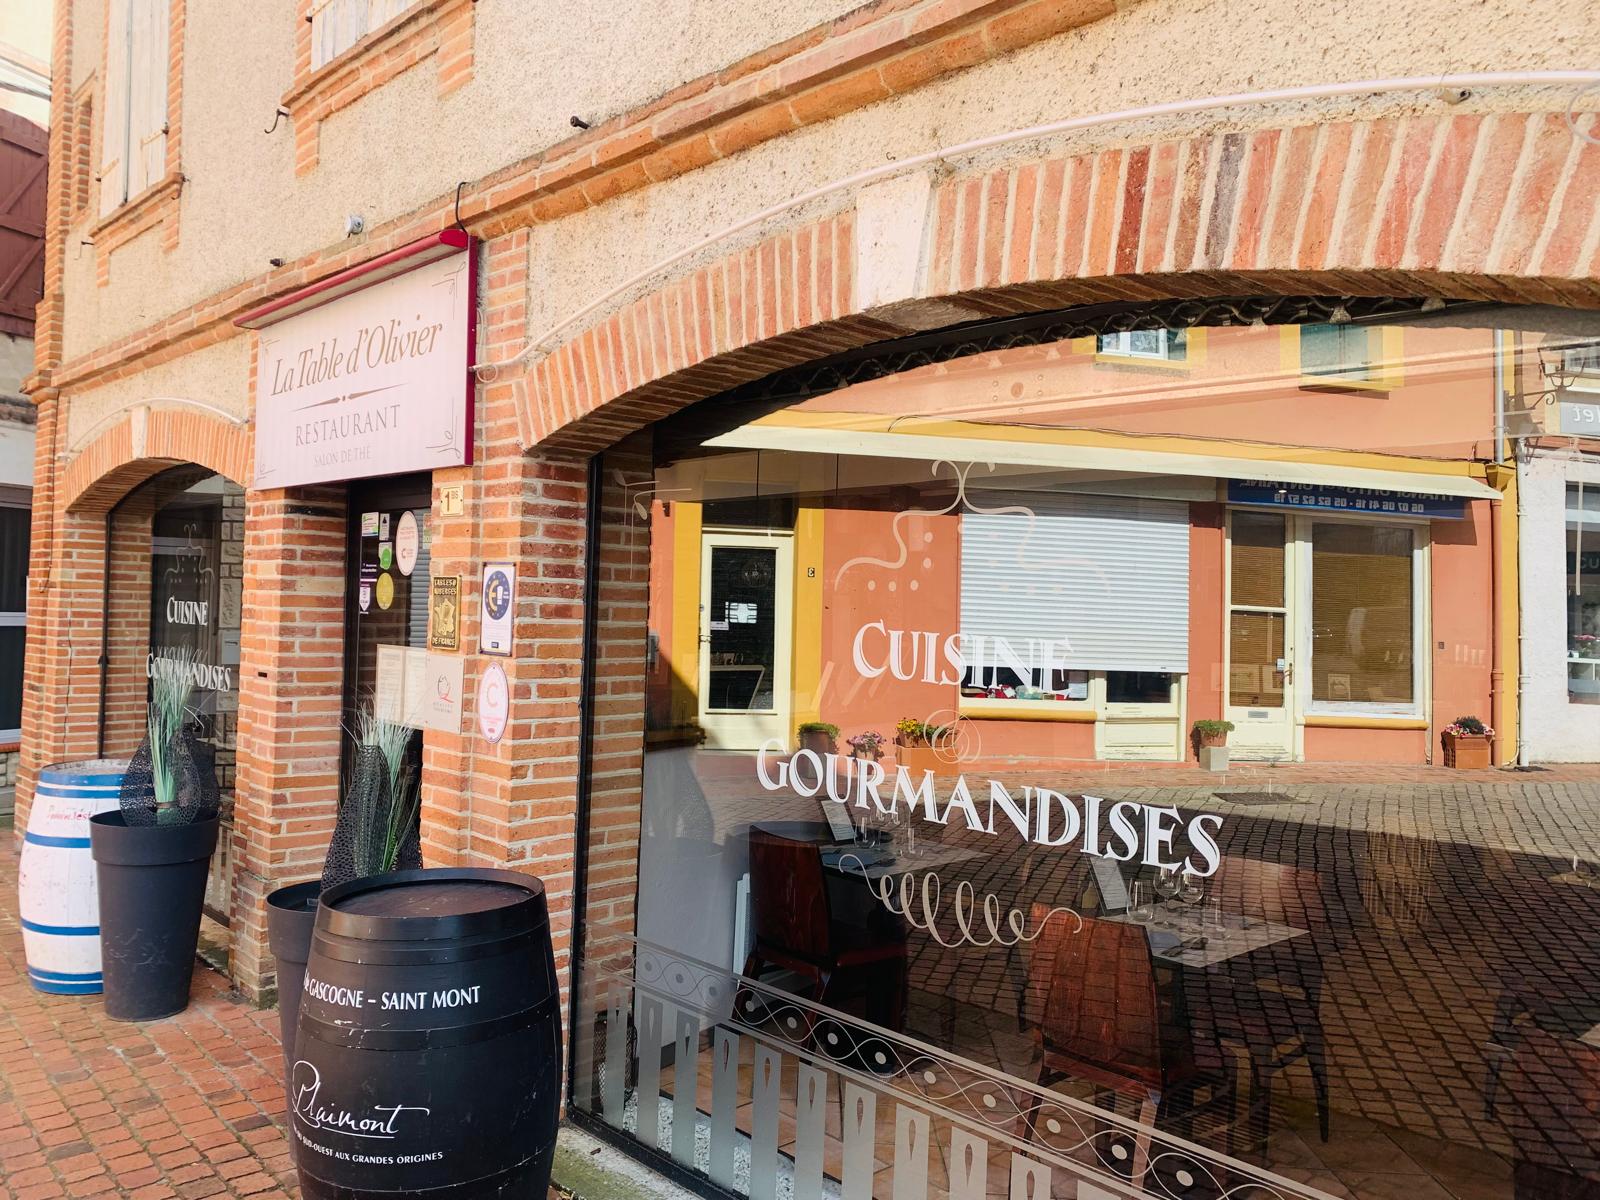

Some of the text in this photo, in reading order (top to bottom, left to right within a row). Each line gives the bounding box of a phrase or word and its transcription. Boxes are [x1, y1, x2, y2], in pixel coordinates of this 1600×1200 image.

[271, 359, 294, 396] La
[297, 338, 343, 389] Table
[295, 404, 401, 447] RESTAURANT
[166, 595, 209, 626] CUISINE
[146, 652, 232, 692] GOURMANDISES
[852, 618, 1075, 698] CUISINE
[756, 737, 1224, 879] GOURMANDISES
[309, 978, 364, 1009] GASCOGNE
[381, 991, 428, 1011] SAINT
[432, 985, 481, 1009] MONT
[334, 1151, 350, 1161] AUX
[352, 1154, 394, 1165] GRANDES
[396, 1151, 444, 1165] ORIGINES
